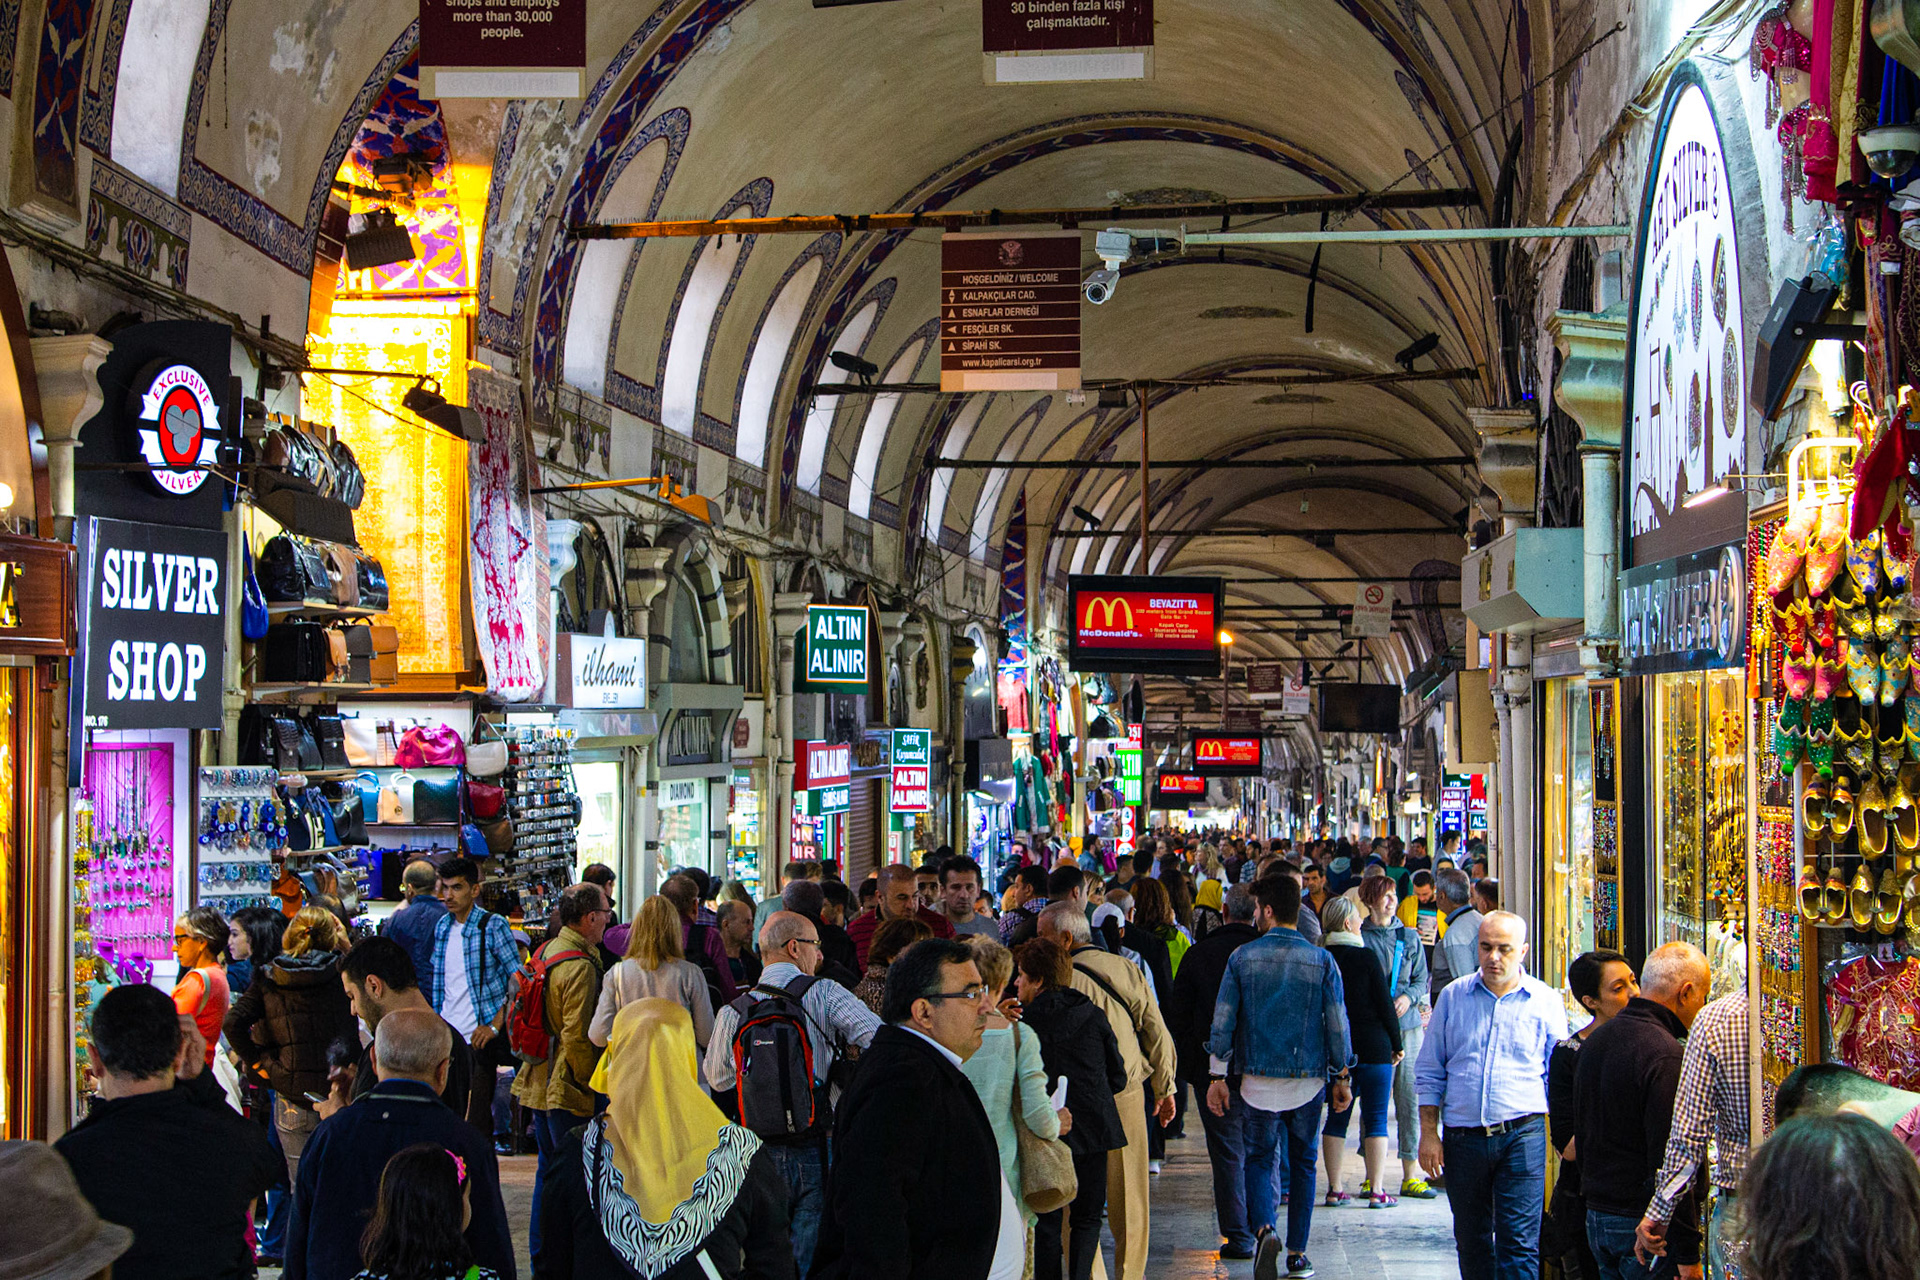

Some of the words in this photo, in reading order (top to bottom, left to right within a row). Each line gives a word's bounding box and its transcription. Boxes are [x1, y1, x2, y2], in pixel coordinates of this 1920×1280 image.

[1011, 2, 1025, 14] 30
[1028, 0, 1069, 13] binden
[1073, 0, 1101, 11] fazla
[453, 12, 483, 22] more
[485, 11, 512, 22] than
[514, 11, 553, 24] 30,000
[1026, 15, 1110, 32] çalışmaktadır.
[481, 26, 524, 40] people.
[1652, 171, 1671, 264] ART
[1672, 141, 1708, 229] SILVER
[962, 272, 1014, 286] HOŞGELDİNİZ
[1019, 272, 1059, 283] WELCOME
[962, 290, 1016, 302] KALPAKÇILAR
[1017, 290, 1037, 300] CAD.
[962, 307, 1003, 318] ESNAFLAR
[1005, 305, 1039, 316] DERNEĞİ
[962, 322, 1000, 335] FESÇİLER
[1001, 324, 1014, 333] SK.
[962, 340, 988, 351] SİPAHİ
[989, 341, 1002, 350] SK.
[962, 357, 1042, 368] www.kapalicarsi.org.tr
[159, 470, 202, 491] SILVER
[101, 547, 219, 616] SILVER
[1149, 599, 1198, 609] BEYAZIT'TA
[815, 615, 862, 640] ALTIN
[1079, 629, 1139, 637] McDonald's
[583, 643, 637, 687] ilhami
[811, 649, 865, 674] ALINIR
[107, 640, 206, 702] SHOP
[810, 750, 828, 780] ALTIN
[895, 770, 927, 786] ALTIN
[893, 790, 928, 806] ALINIR
[1443, 790, 1462, 799] ALTIN
